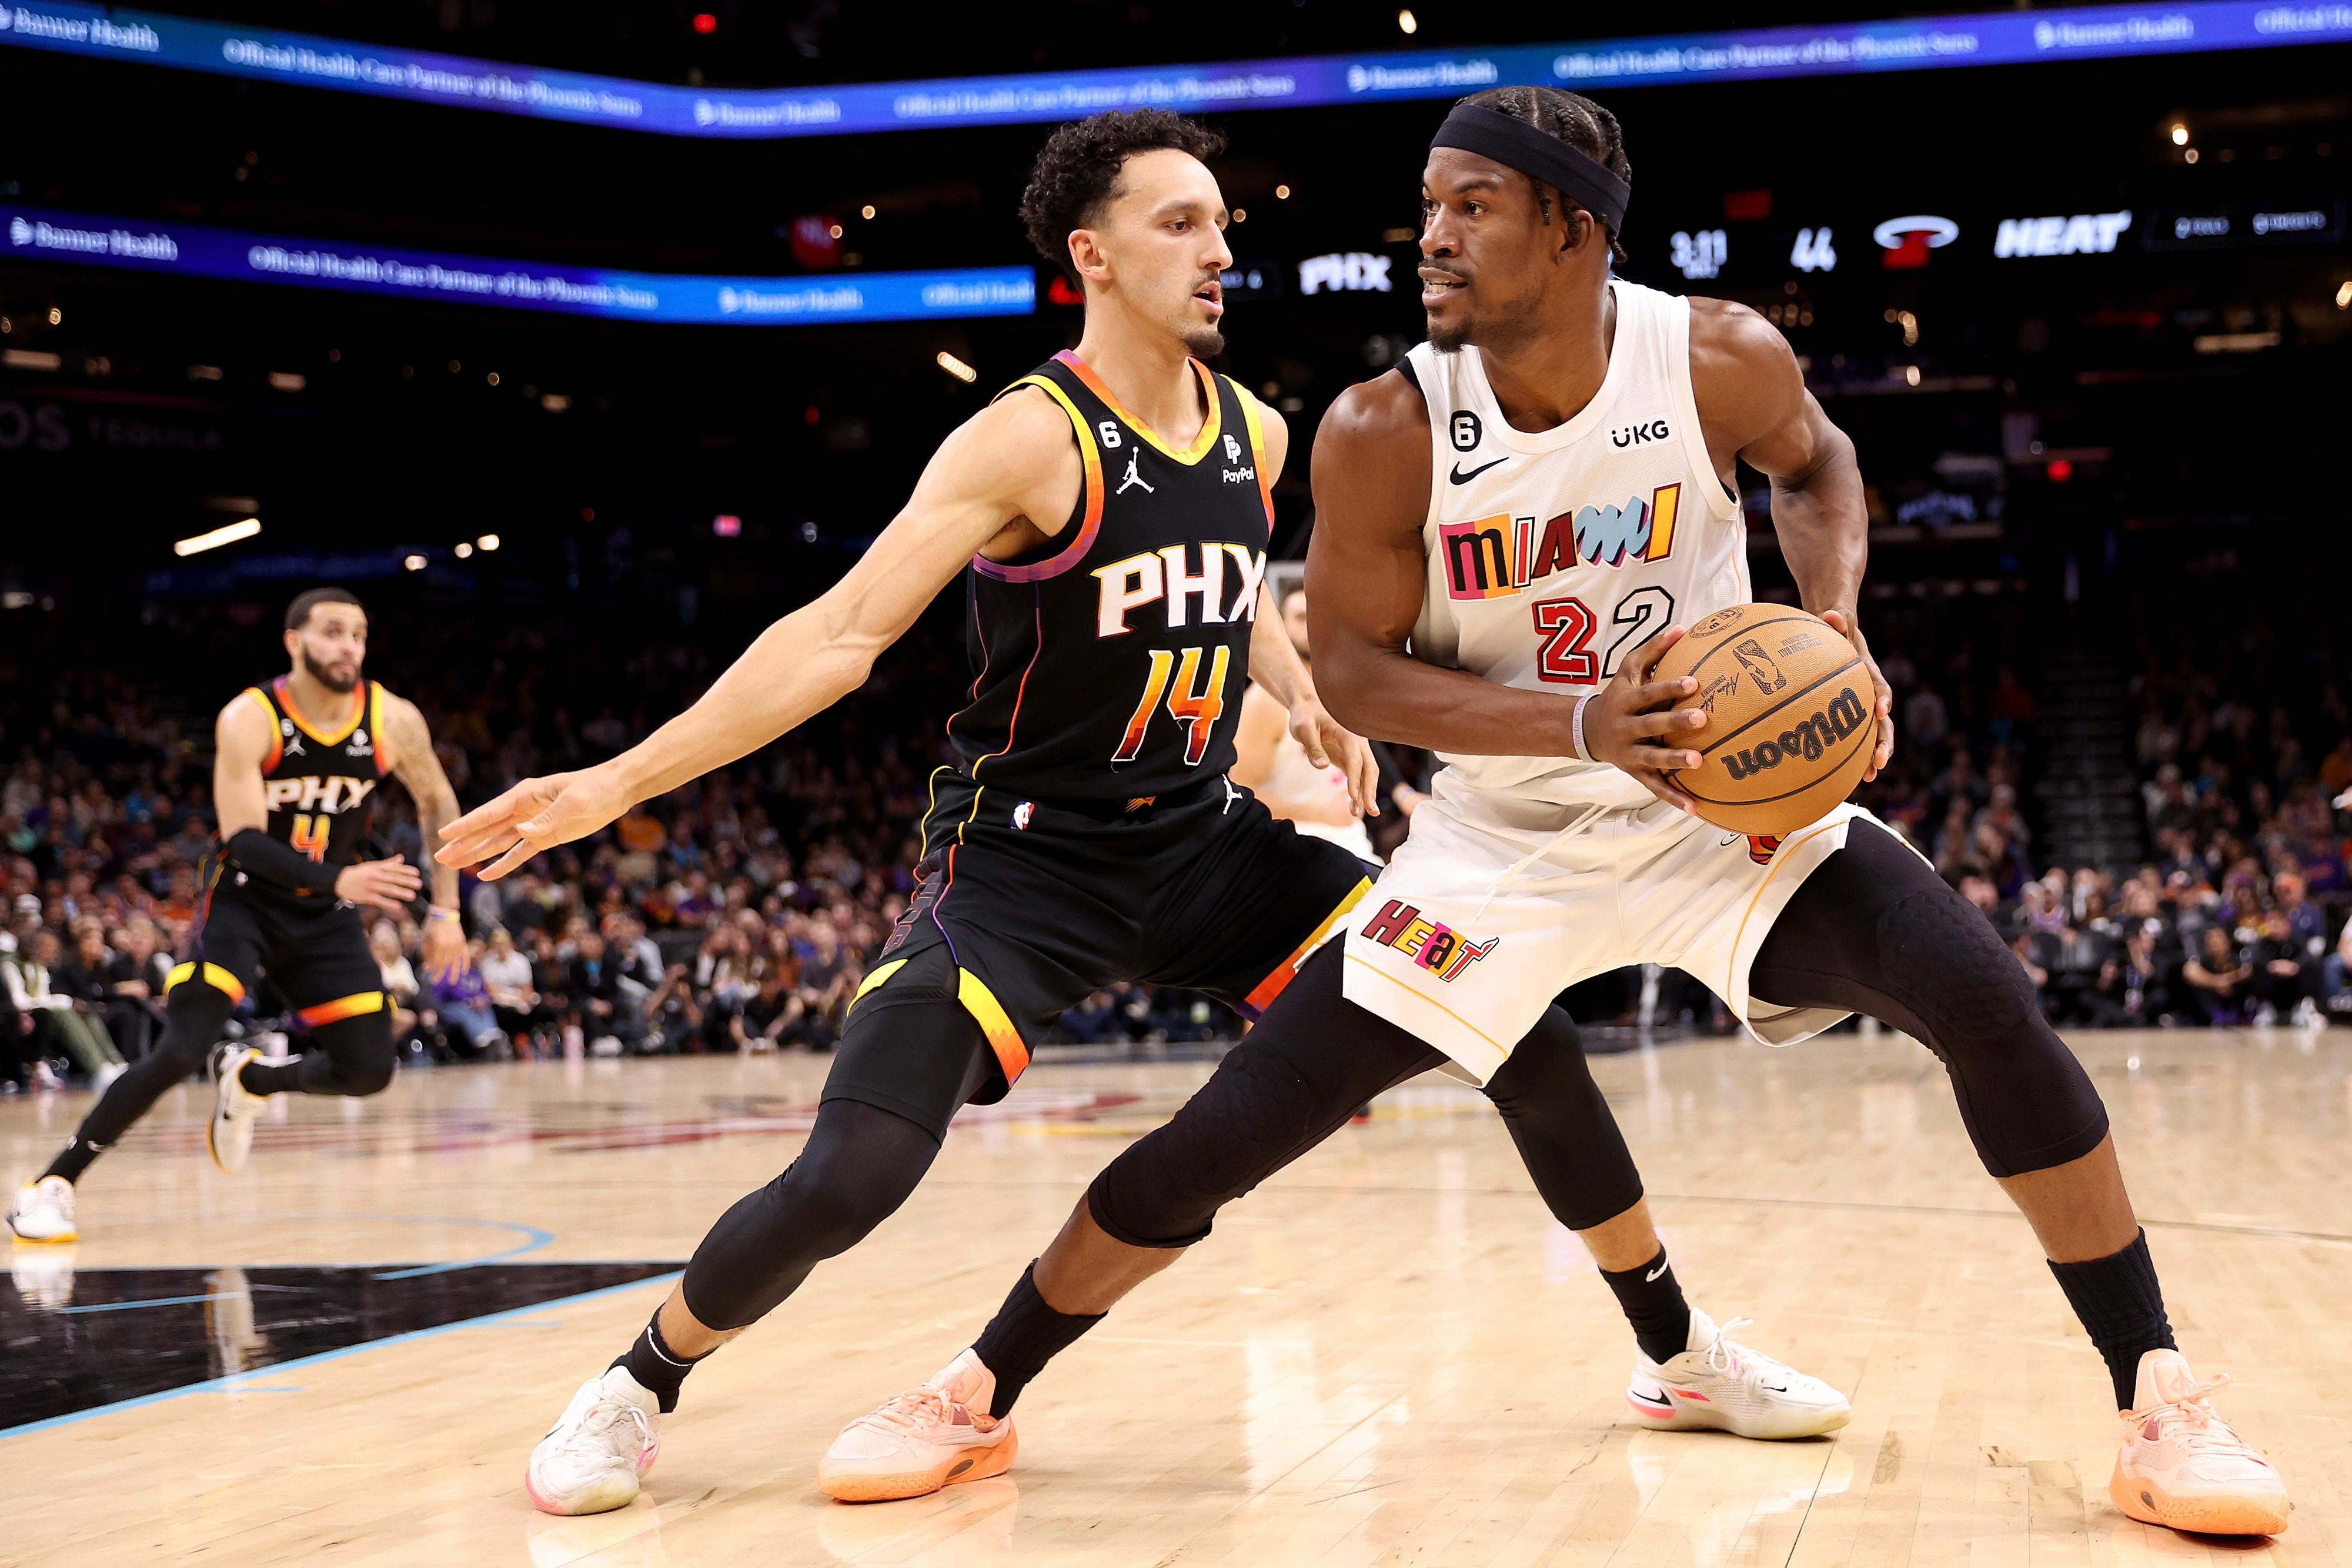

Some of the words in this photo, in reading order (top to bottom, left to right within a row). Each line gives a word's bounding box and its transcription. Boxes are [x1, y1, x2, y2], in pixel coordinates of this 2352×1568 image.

[90, 18, 159, 52] Health
[35, 221, 108, 253] Banner
[110, 229, 178, 260] Health
[1994, 210, 2132, 258] HEAT
[1299, 253, 1392, 295] PHX
[1098, 420, 1122, 449] 6
[1455, 416, 1476, 447] 6
[1222, 466, 1254, 484] PayPal
[1090, 542, 1267, 639] PHX
[1531, 586, 1675, 686] 22
[1111, 646, 1230, 766] 14
[1701, 674, 1726, 698] COMMISSIONER
[1722, 688, 1867, 780] Wilson
[290, 814, 330, 862] 4
